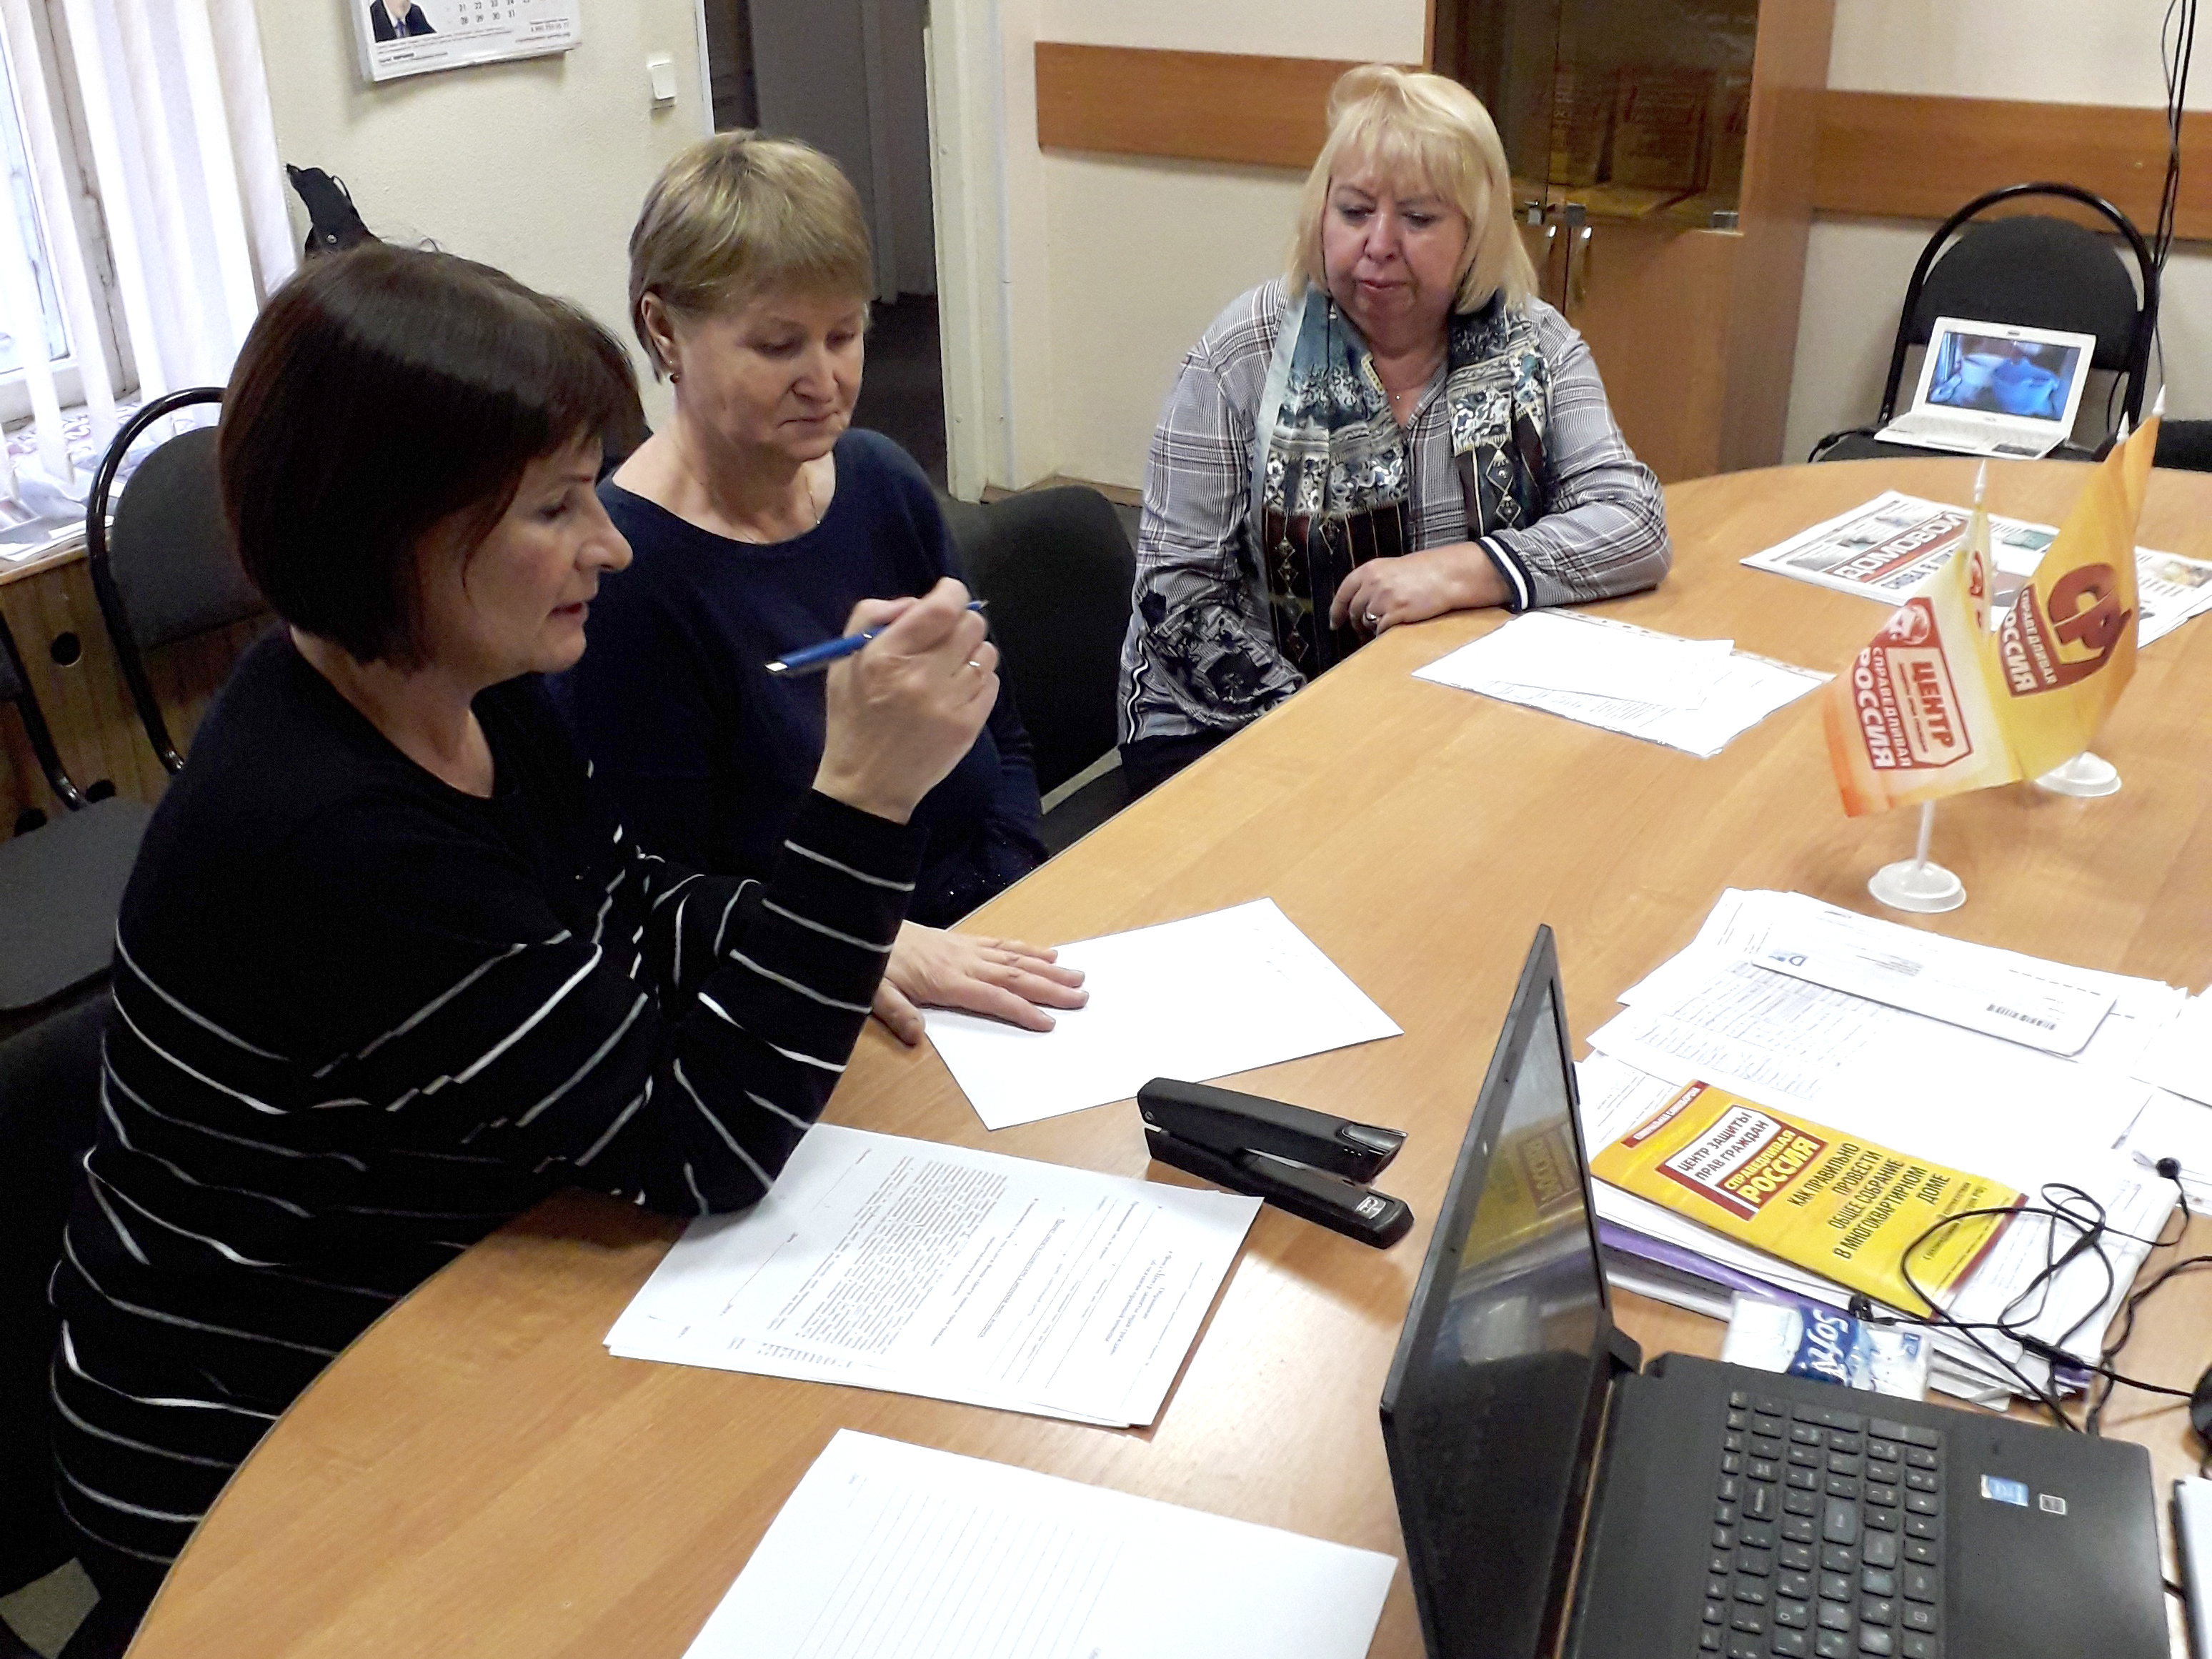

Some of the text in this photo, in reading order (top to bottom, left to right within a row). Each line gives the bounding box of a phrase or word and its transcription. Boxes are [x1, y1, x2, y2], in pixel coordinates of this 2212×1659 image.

[2002, 602, 2038, 693] ОССИЯ
[1855, 646, 1896, 767] РОССИЯ
[1911, 662, 1956, 748] ЦЕНТР
[1677, 1146, 1713, 1172] ЦЕНТР
[1706, 1111, 1753, 1150] ЗАЩИТЫ
[1694, 1120, 1770, 1182] ПРАВ ГРАЖДАН
[1736, 1136, 1823, 1205] РОССИЯ
[1787, 1142, 1860, 1207] КАК ПРАВИЛЬНО
[1830, 1150, 1883, 1196] ПРОВЕСТИ
[1827, 1157, 1905, 1230] ОБЩЕЕ СОБРАНИЕ
[1832, 1165, 1928, 1260] В МНОГОКВАРТИРНОМ
[1916, 1172, 1951, 1206] ДОМЕ
